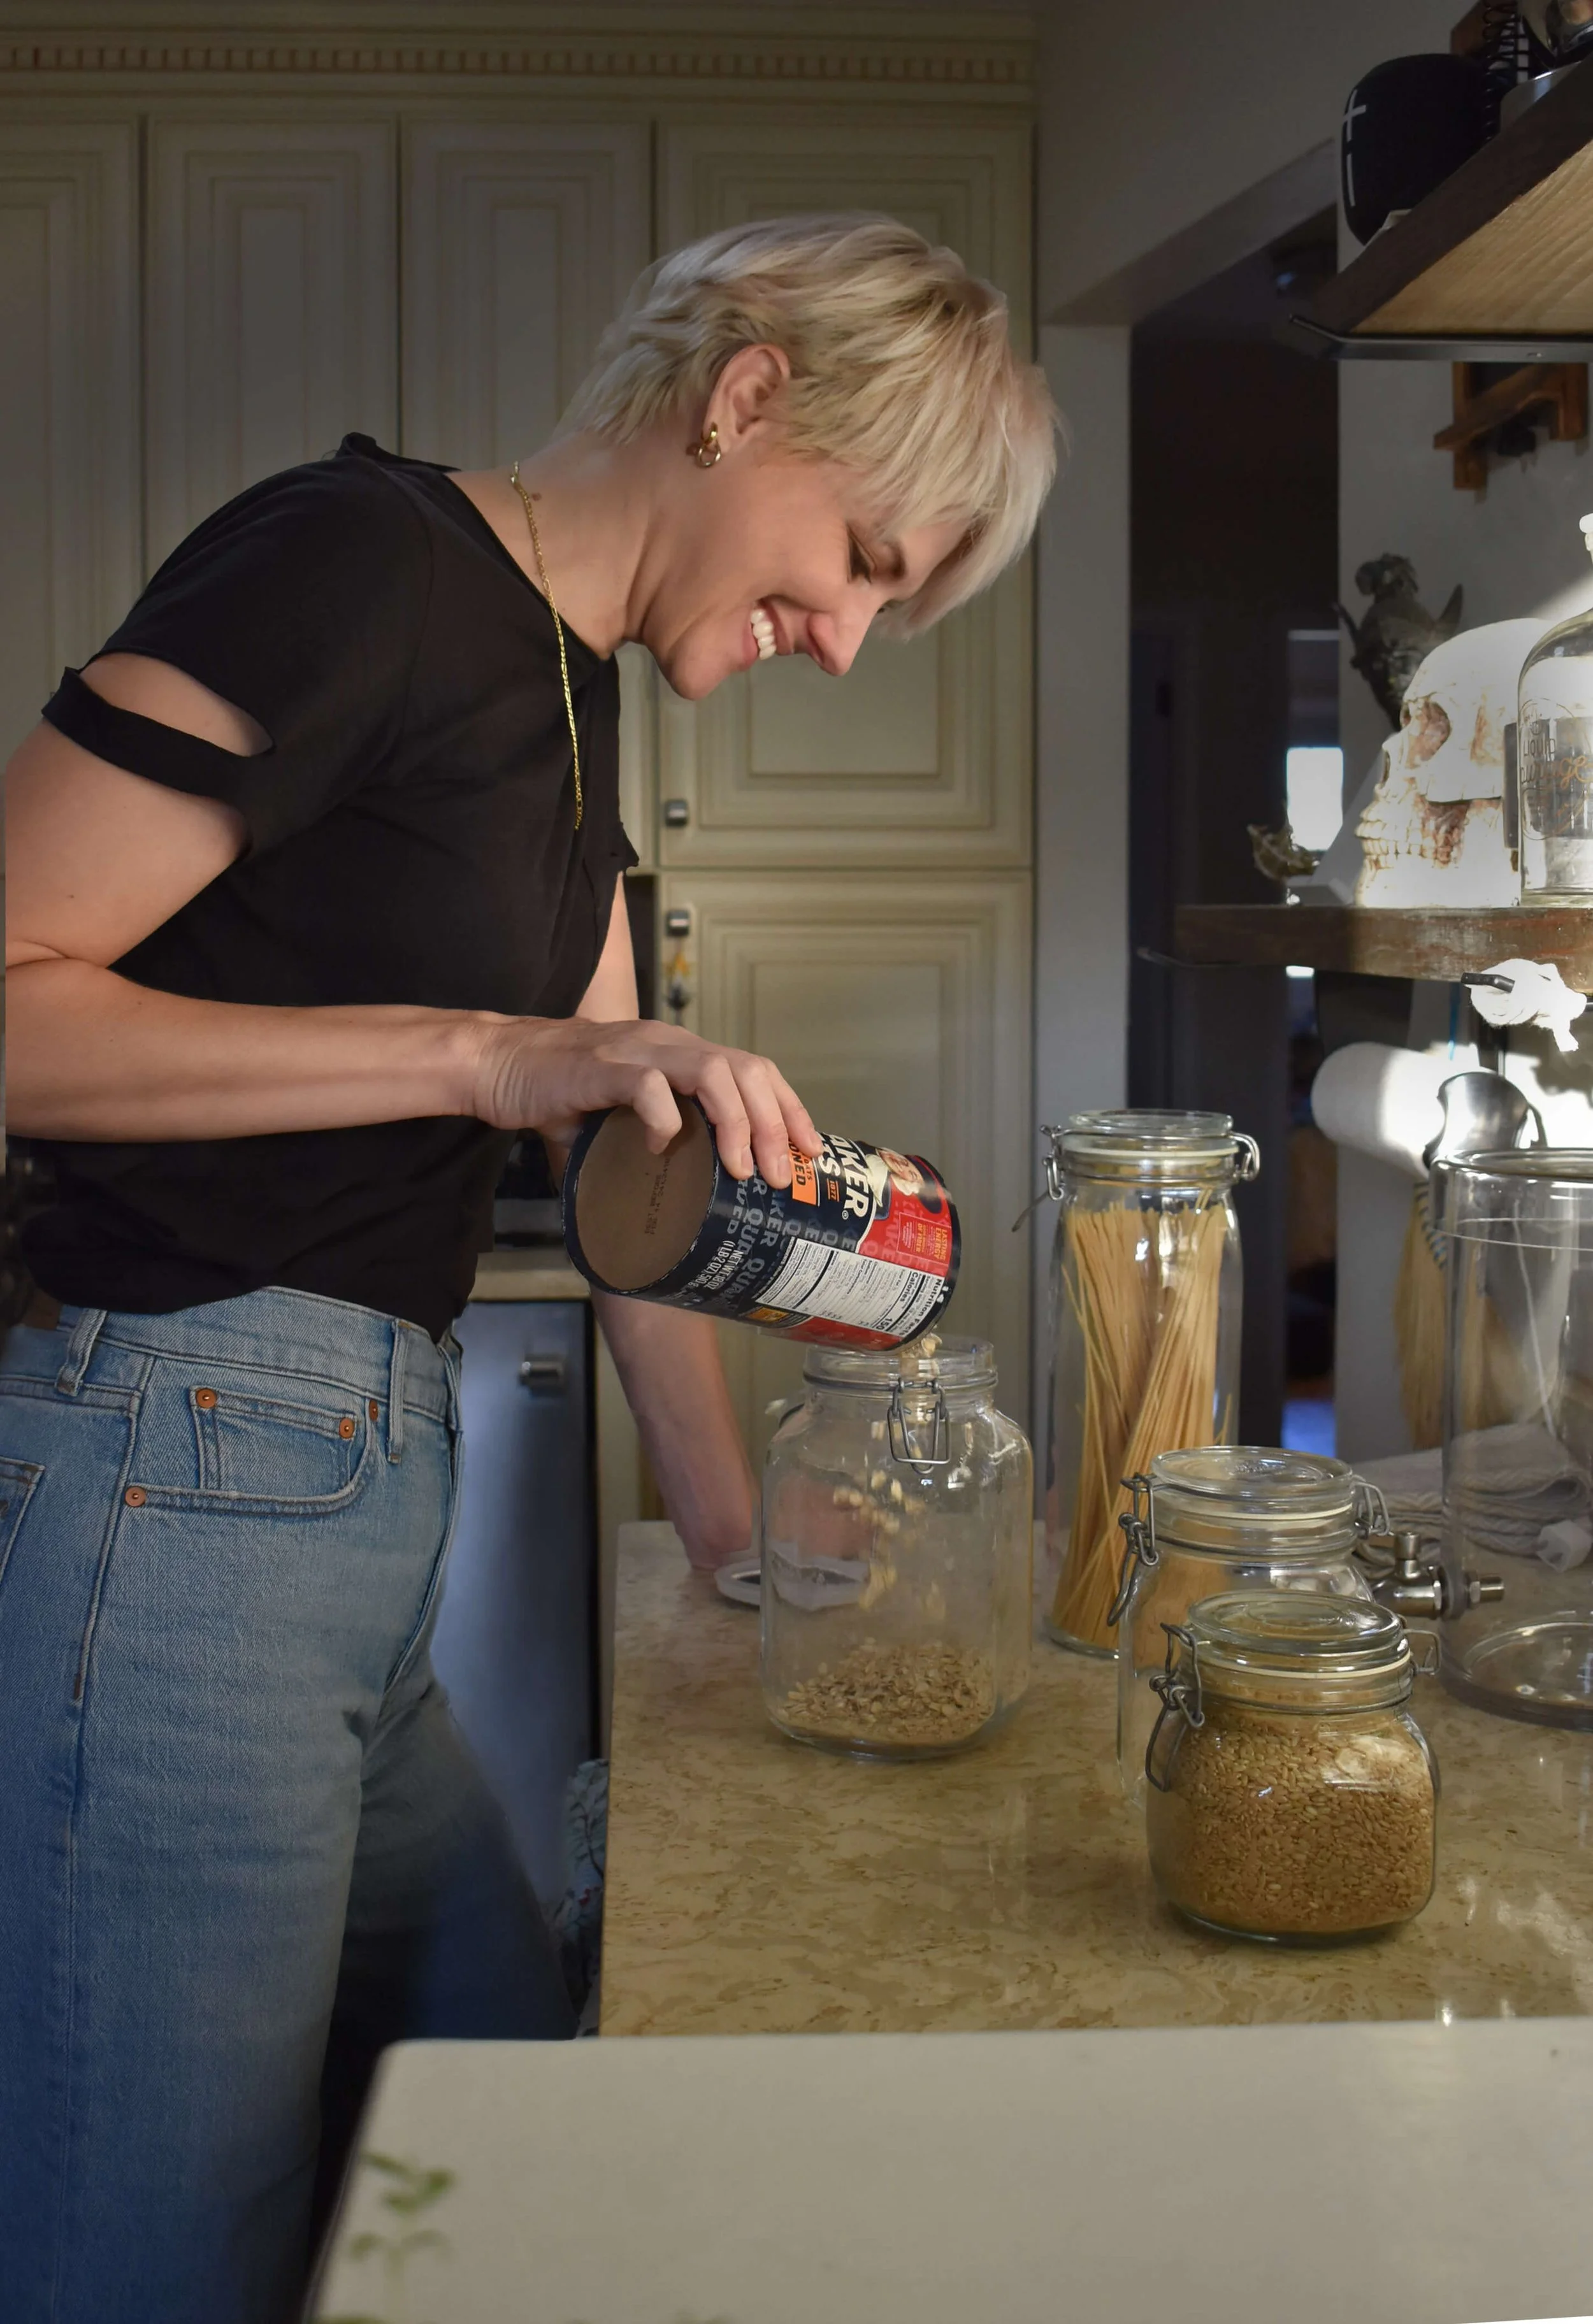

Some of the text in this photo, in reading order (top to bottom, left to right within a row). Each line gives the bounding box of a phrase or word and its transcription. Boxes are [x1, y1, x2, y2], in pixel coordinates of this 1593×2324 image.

[789, 1142, 805, 1186] ONED
[817, 1133, 840, 1176] TS
[828, 1135, 869, 1217] AKER
[737, 1208, 763, 1255] QUA
[718, 1247, 732, 1258] LB
[728, 1250, 744, 1265] NET
[900, 1272, 918, 1302] Calories
[919, 1279, 942, 1316] Nutrition
[876, 1318, 892, 1330] 150
[899, 1318, 920, 1336] Facts
